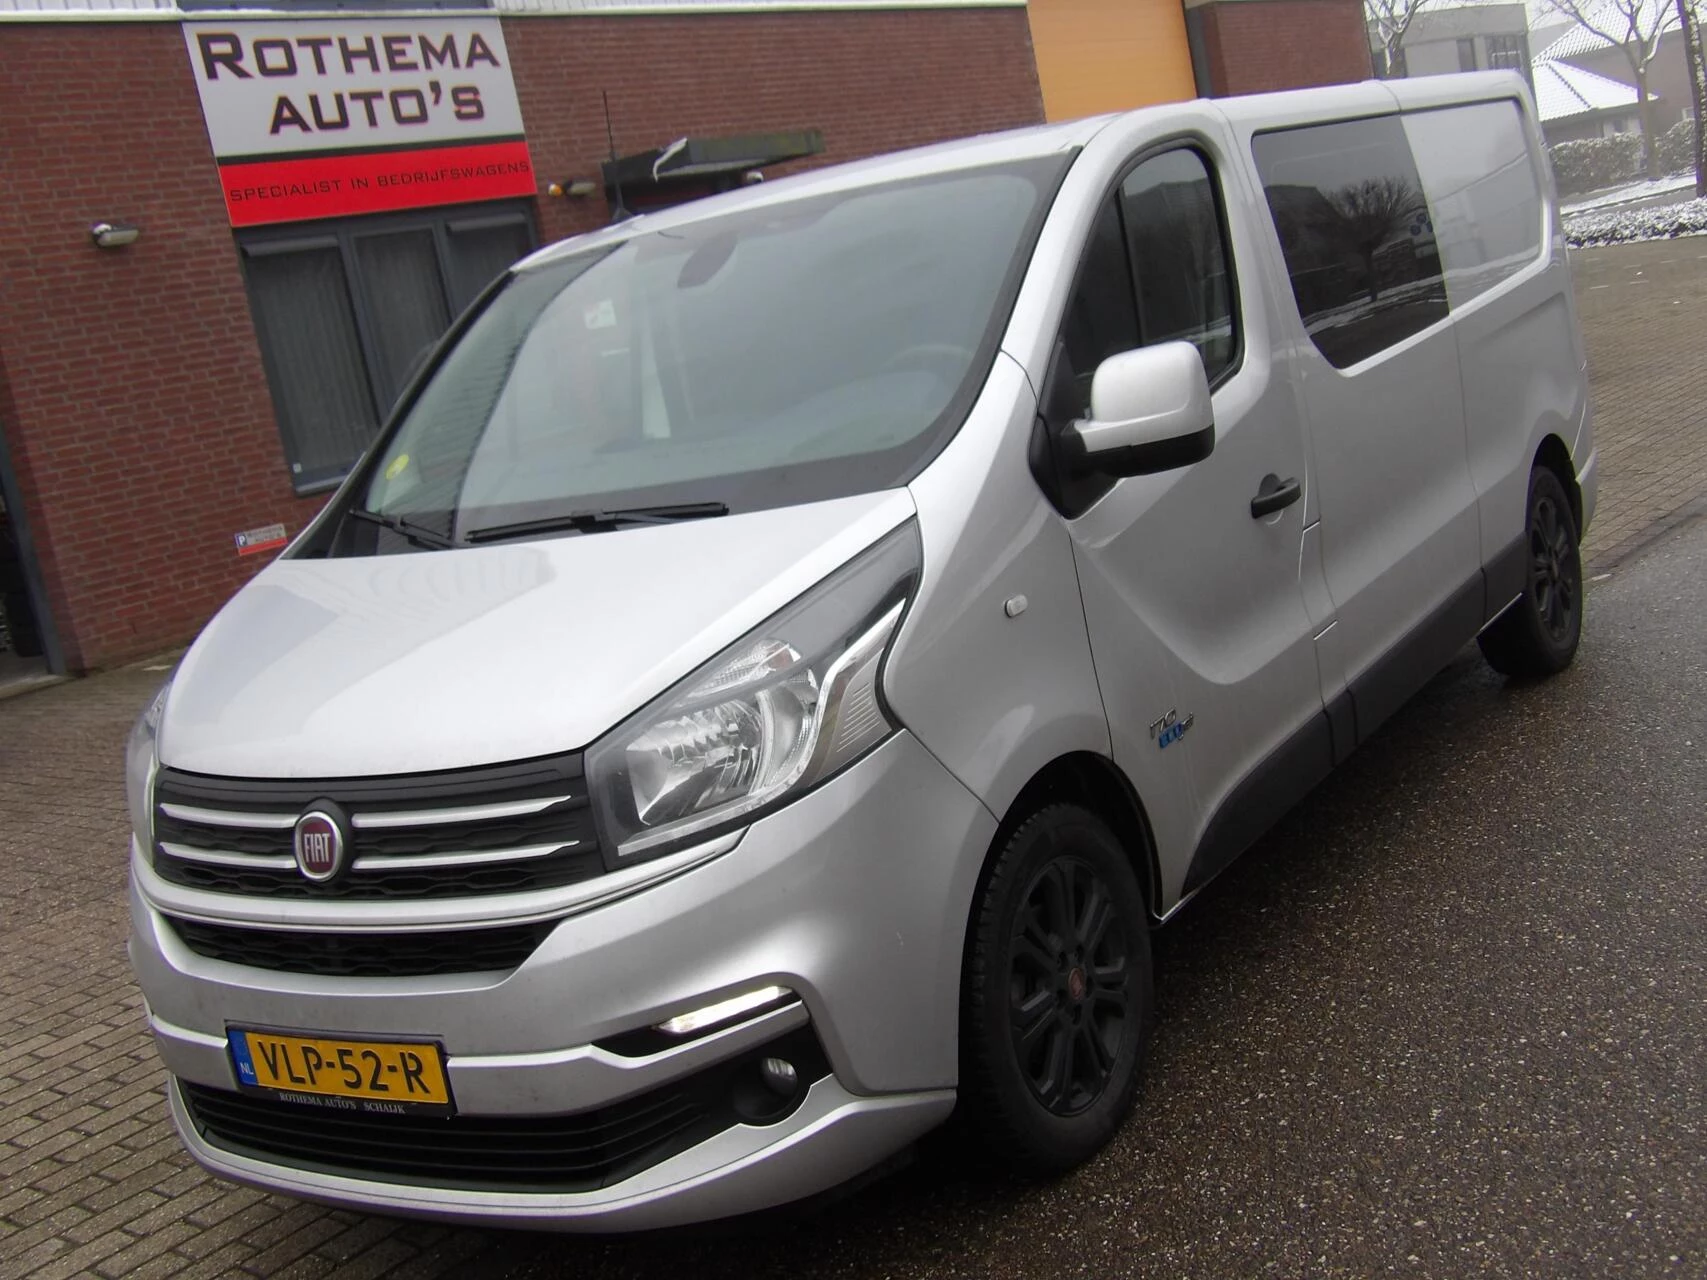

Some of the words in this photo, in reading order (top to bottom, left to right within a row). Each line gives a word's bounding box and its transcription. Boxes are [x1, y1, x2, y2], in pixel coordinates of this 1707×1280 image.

[196, 32, 501, 80] ROTHEMA
[269, 80, 485, 135] AUTO'S
[230, 178, 342, 202] SPECIALIST
[351, 177, 369, 190] IN
[377, 161, 530, 188] BEDRIJFSWAGENS
[304, 833, 330, 863] FIAT
[240, 1062, 254, 1075] NL
[257, 1041, 430, 1094] VLP-52-R
[279, 1092, 322, 1106] ROTHEMA
